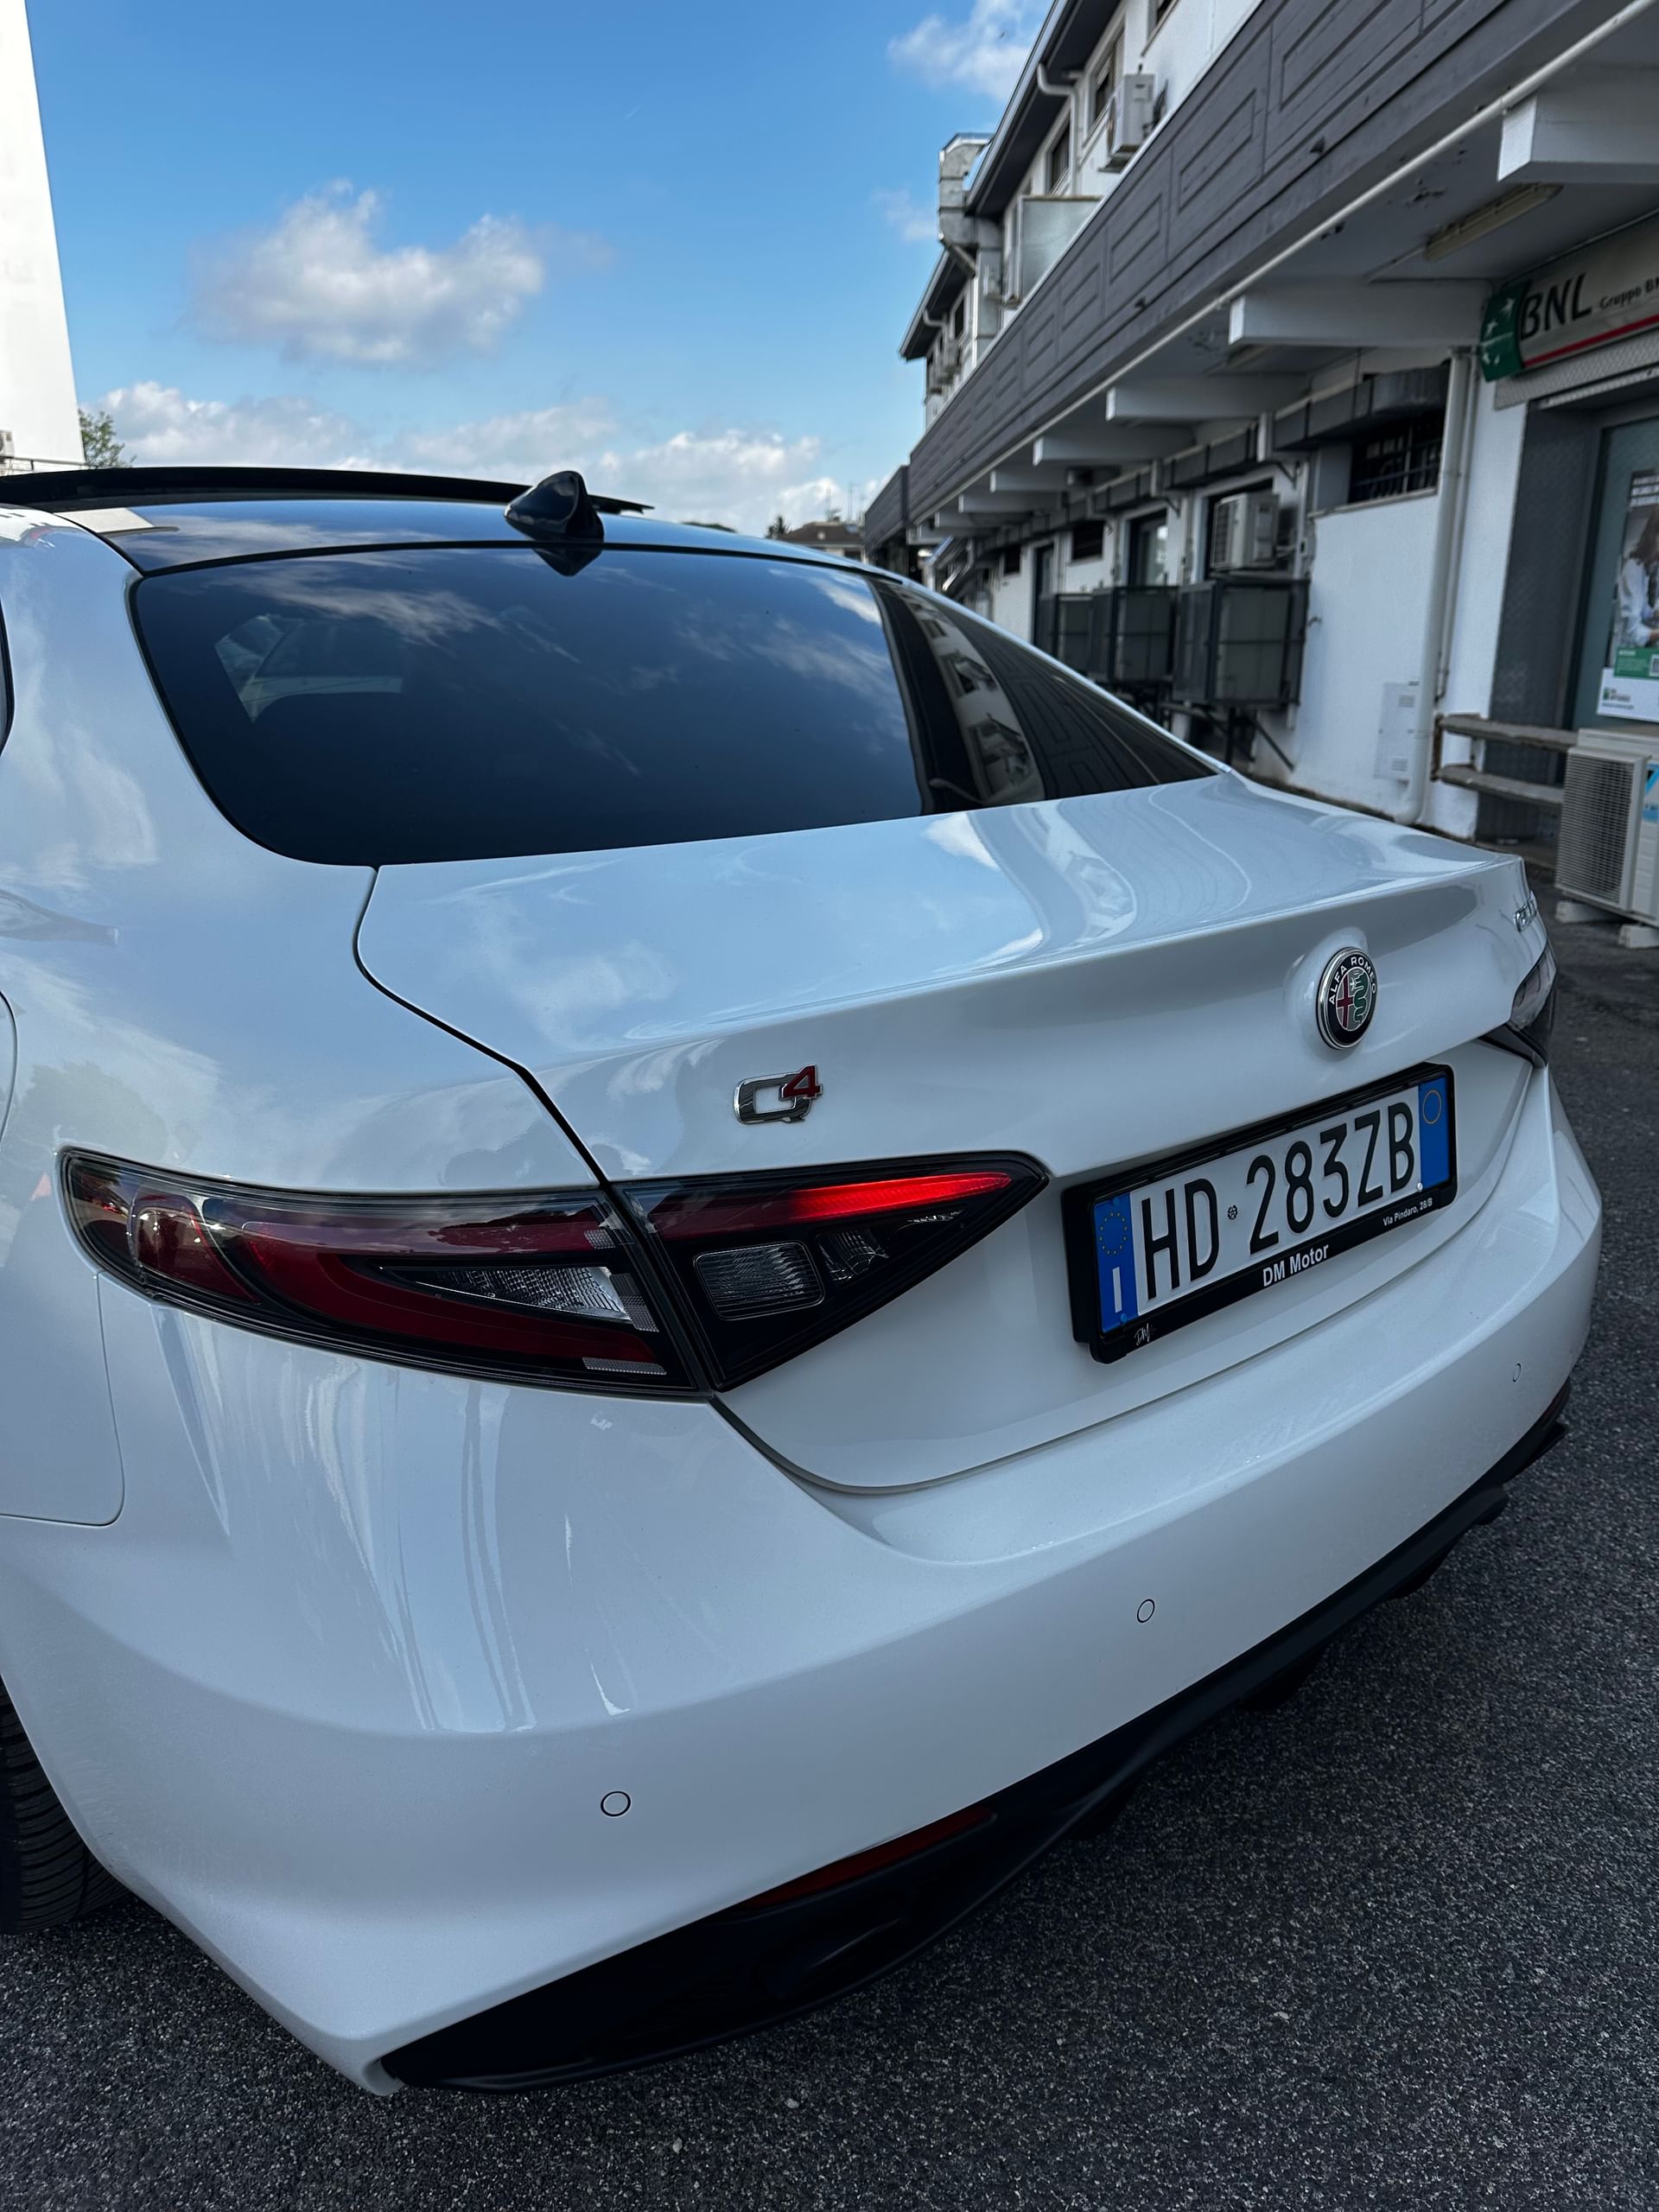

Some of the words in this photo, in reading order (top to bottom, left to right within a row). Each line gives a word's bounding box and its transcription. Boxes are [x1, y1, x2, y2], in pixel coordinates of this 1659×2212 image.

[1519, 271, 1593, 341] BNL
[1599, 287, 1642, 309] Gruppo
[1329, 965, 1348, 1005] ALFA
[1351, 957, 1376, 994] ROMEO
[1141, 1178, 1219, 1300] HD
[1246, 1102, 1414, 1255] 283ZB
[1382, 1216, 1393, 1226] Via
[1394, 1206, 1419, 1222] Pindaro,
[1419, 1197, 1433, 1211] 28/B
[1262, 1260, 1285, 1287] DM
[1289, 1243, 1329, 1274] Motor
